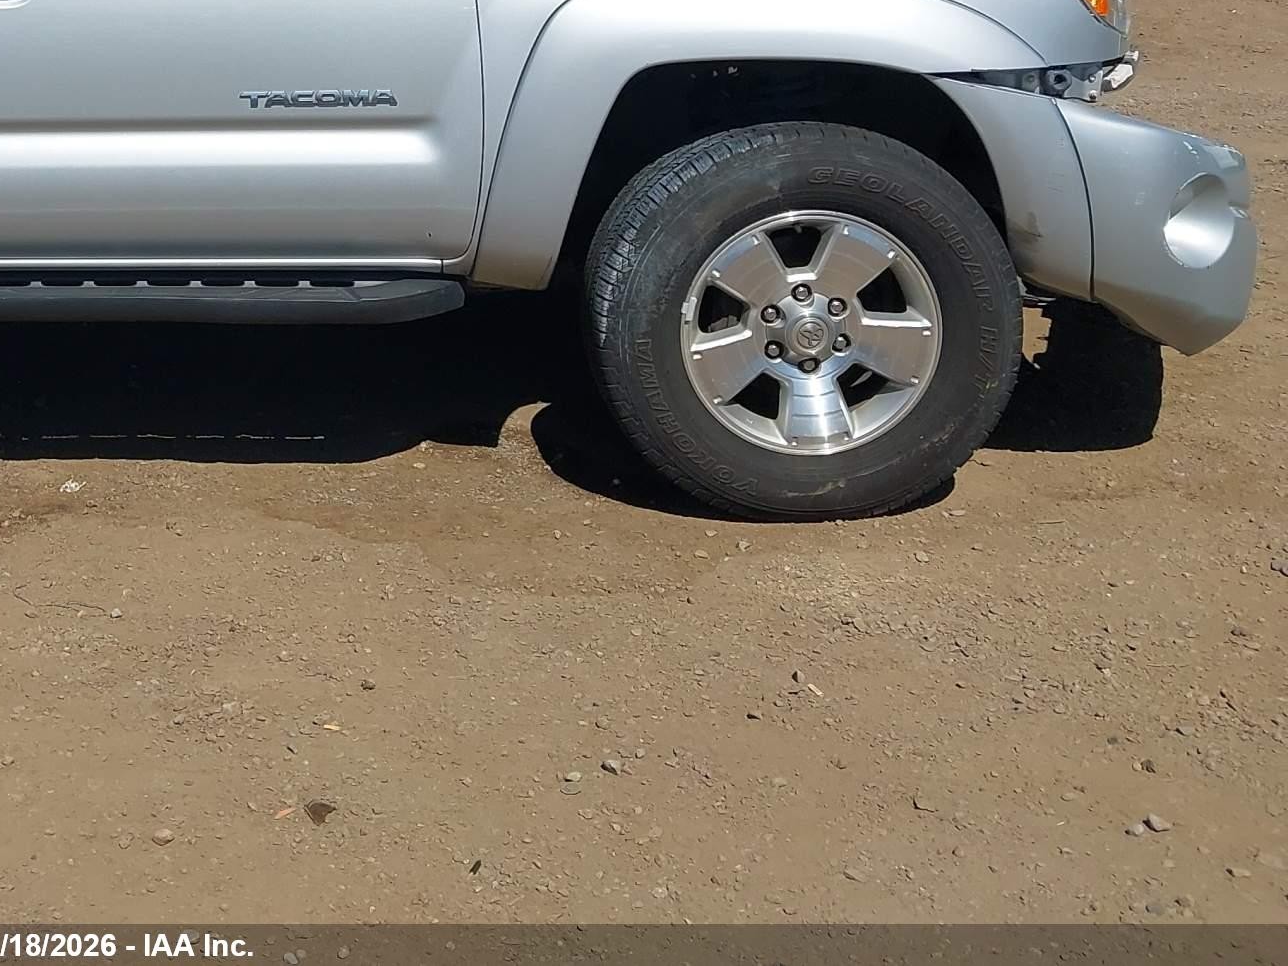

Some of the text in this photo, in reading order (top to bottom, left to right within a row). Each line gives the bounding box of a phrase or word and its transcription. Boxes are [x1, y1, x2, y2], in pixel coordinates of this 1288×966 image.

[239, 90, 398, 108] TACOMA
[808, 166, 994, 312] GEOLANDAR
[634, 338, 759, 496] YOKOHAMA
